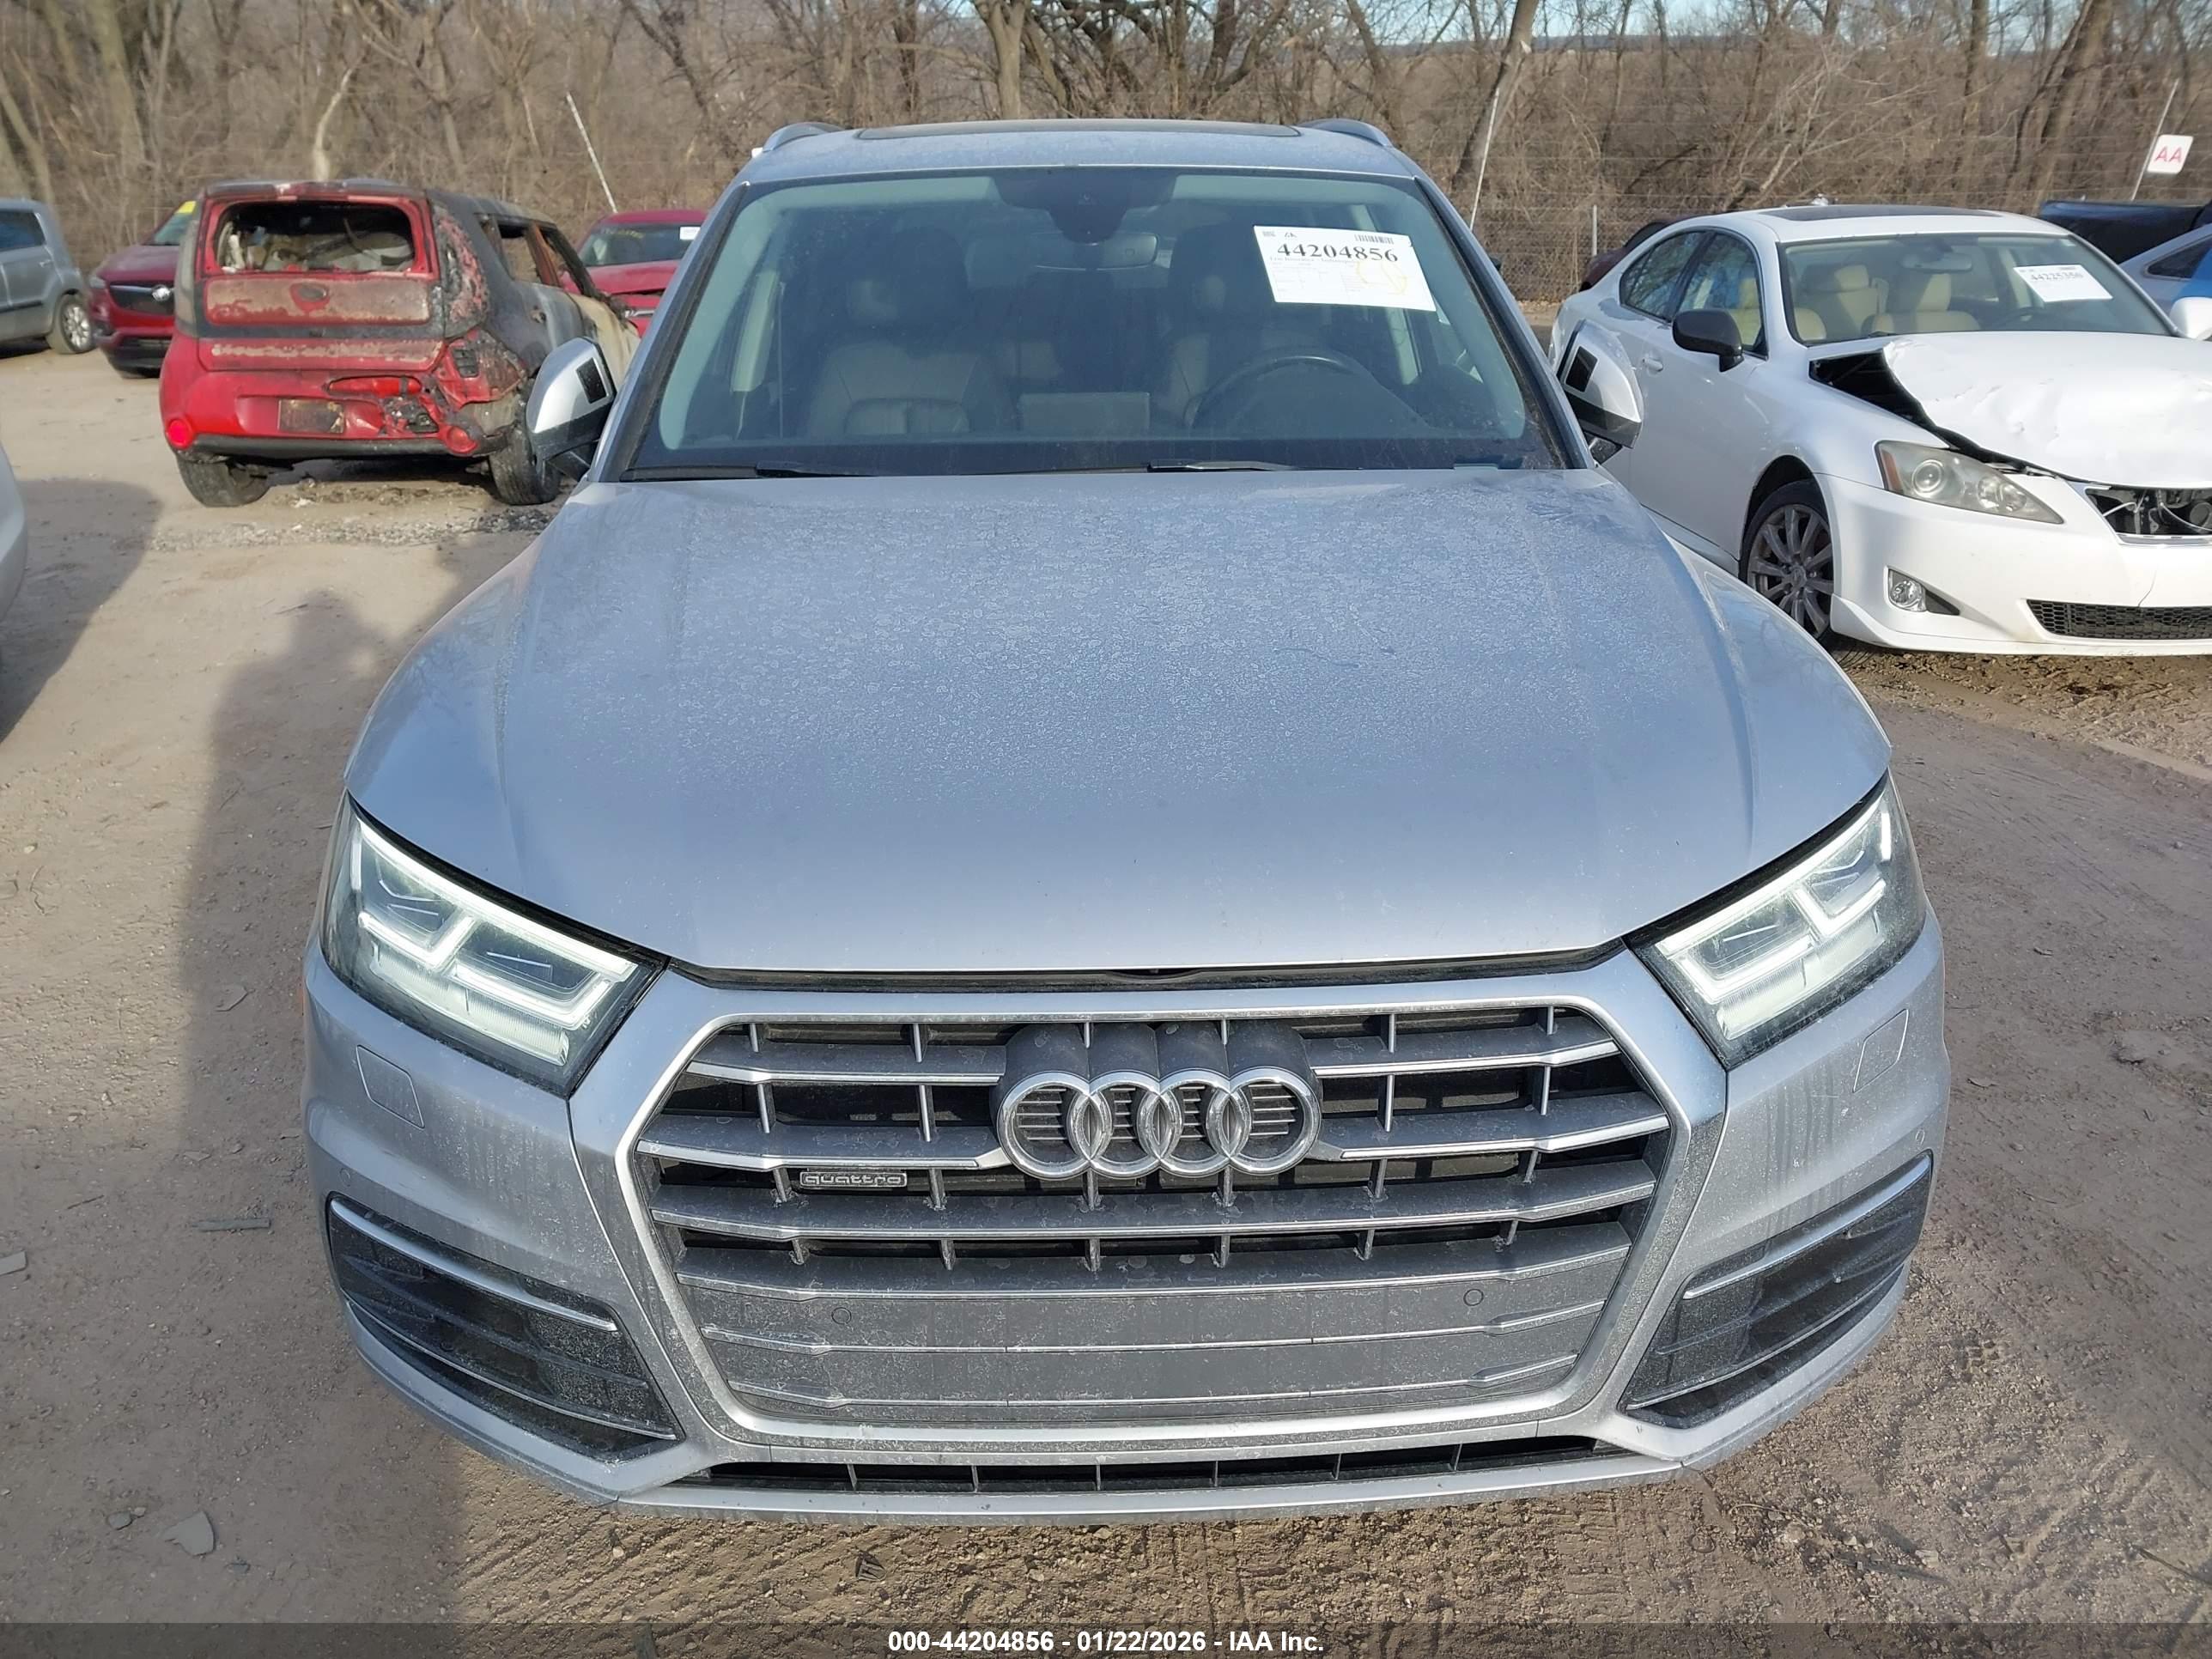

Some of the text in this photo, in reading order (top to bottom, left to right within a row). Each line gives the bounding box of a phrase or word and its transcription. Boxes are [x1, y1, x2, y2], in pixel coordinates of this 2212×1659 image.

[2154, 146, 2182, 162] AA
[1277, 243, 1398, 262] 44204856
[805, 1174, 902, 1186] quattro
